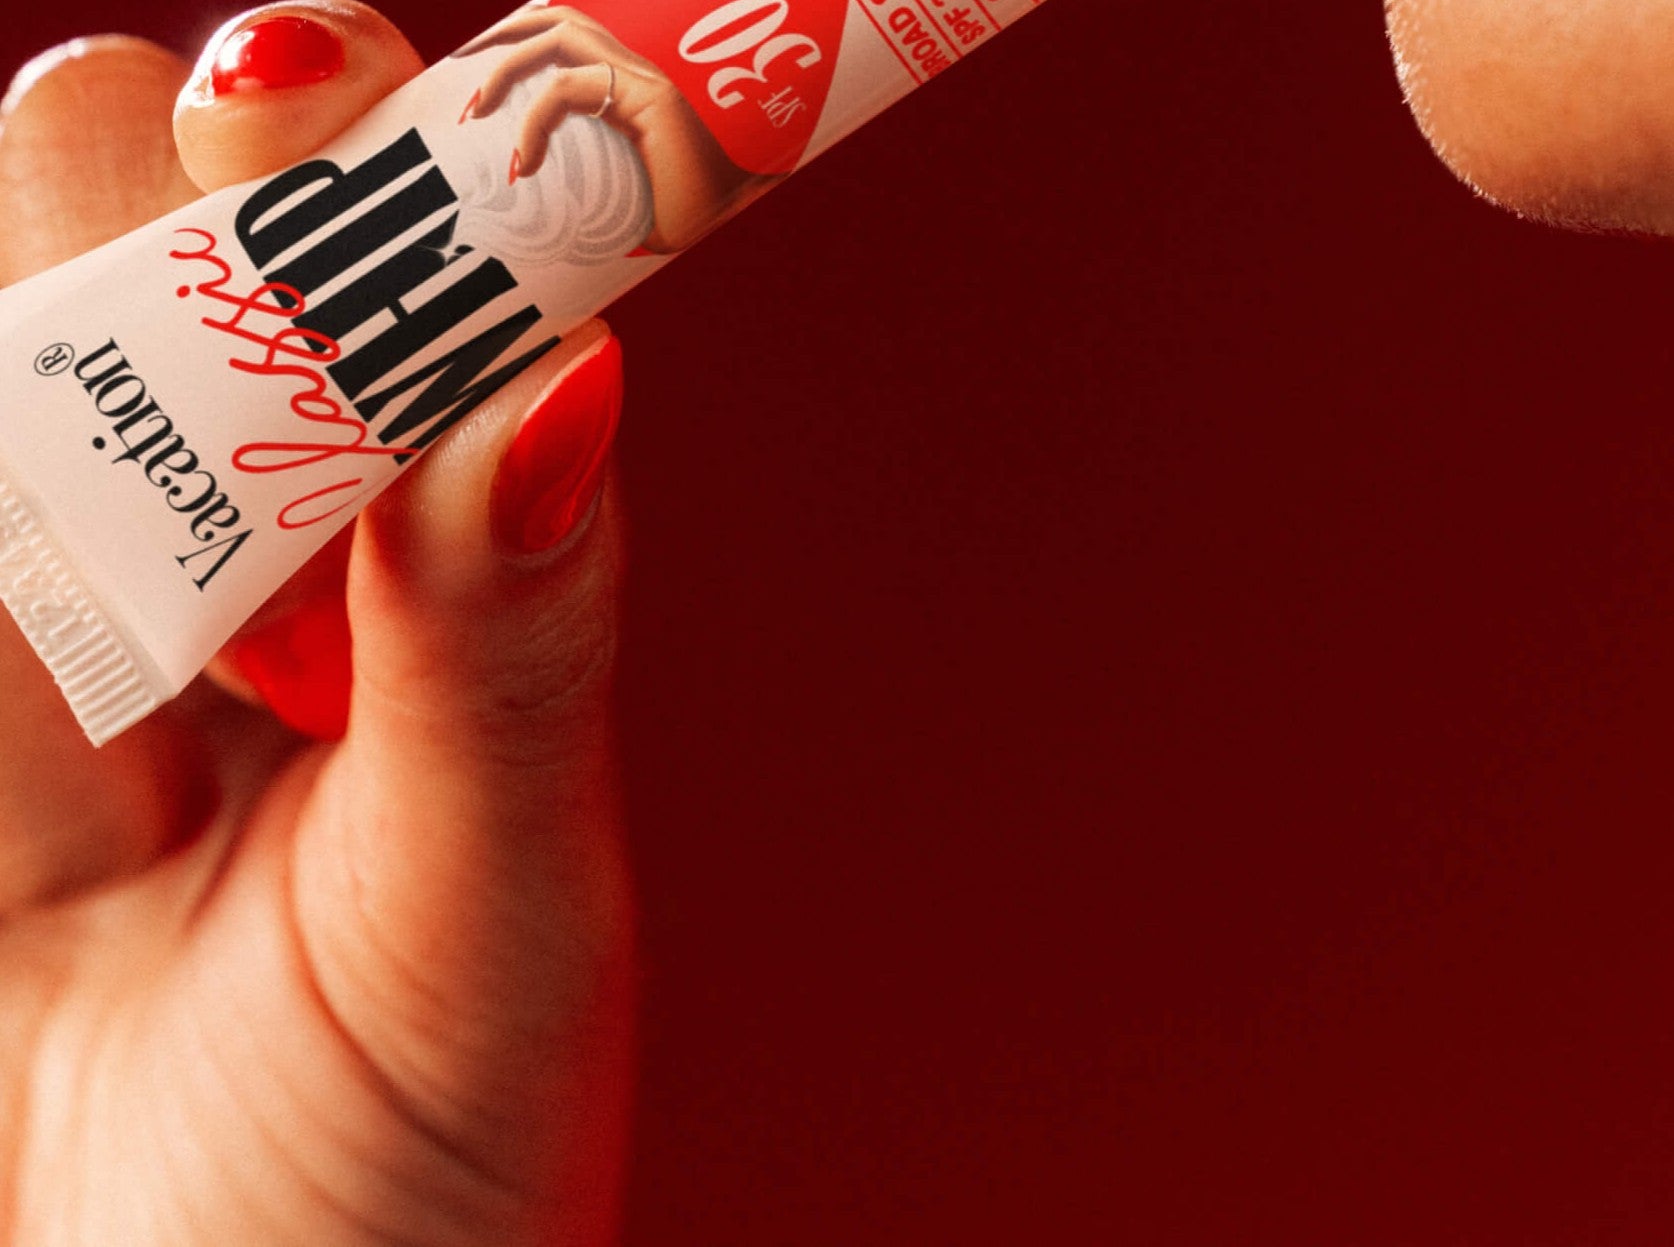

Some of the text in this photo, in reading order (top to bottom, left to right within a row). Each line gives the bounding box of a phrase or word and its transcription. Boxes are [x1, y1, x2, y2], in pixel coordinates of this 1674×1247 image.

[943, 7, 987, 46] SPF
[757, 86, 807, 129] SPF
[235, 128, 562, 466] WHIP
